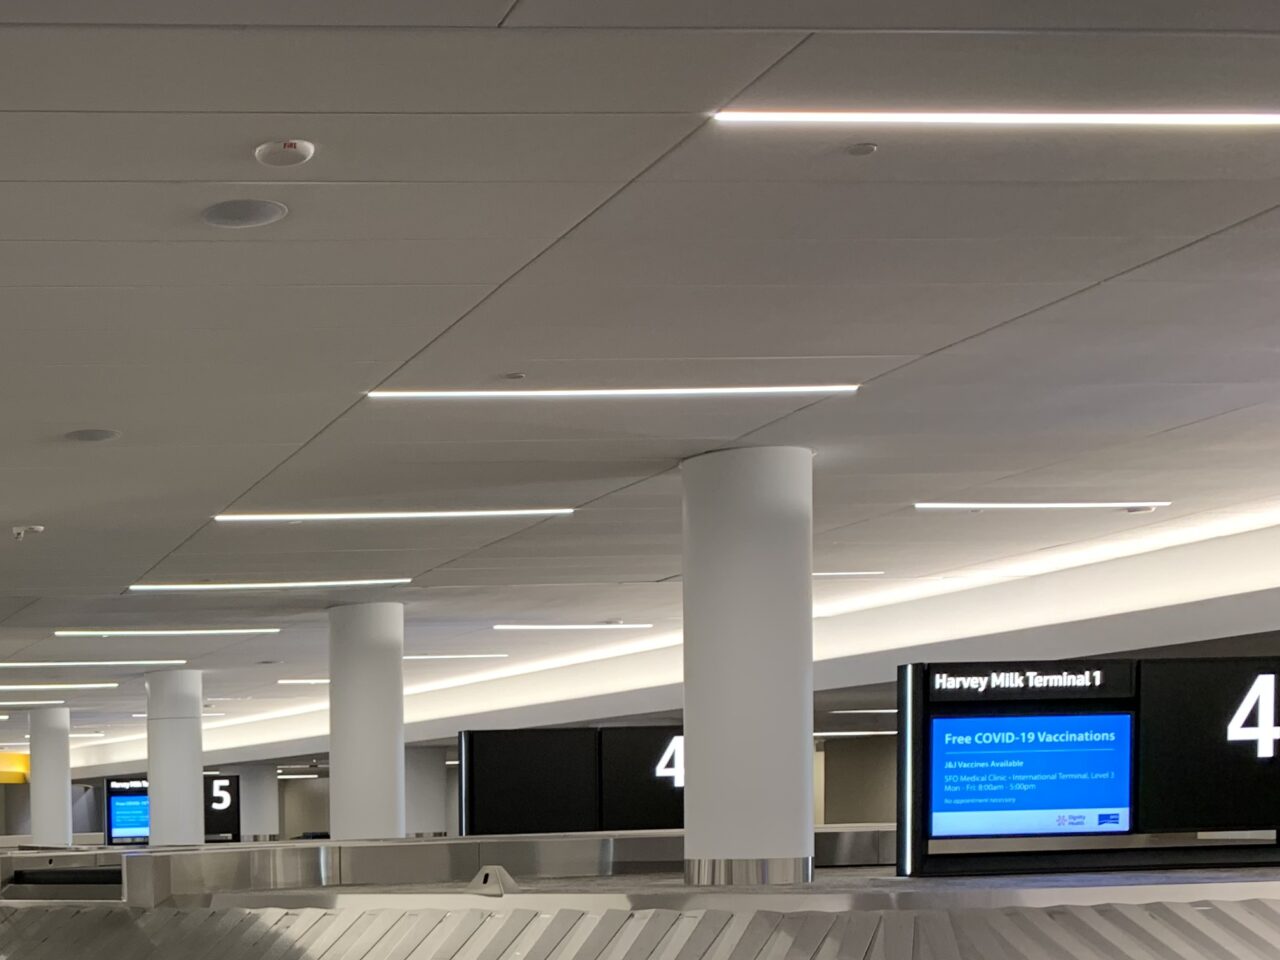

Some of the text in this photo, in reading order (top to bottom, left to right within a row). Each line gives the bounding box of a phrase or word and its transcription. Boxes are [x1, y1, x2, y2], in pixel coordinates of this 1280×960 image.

[934, 670, 1101, 692] Harvey Milk Terminal 1
[1227, 674, 1280, 758] 4
[944, 730, 1116, 745] Free COVID-19 Vaccinations
[958, 760, 989, 769] Vaccines
[990, 760, 1024, 768] Available
[960, 774, 987, 782] Medical
[211, 779, 231, 810] 5
